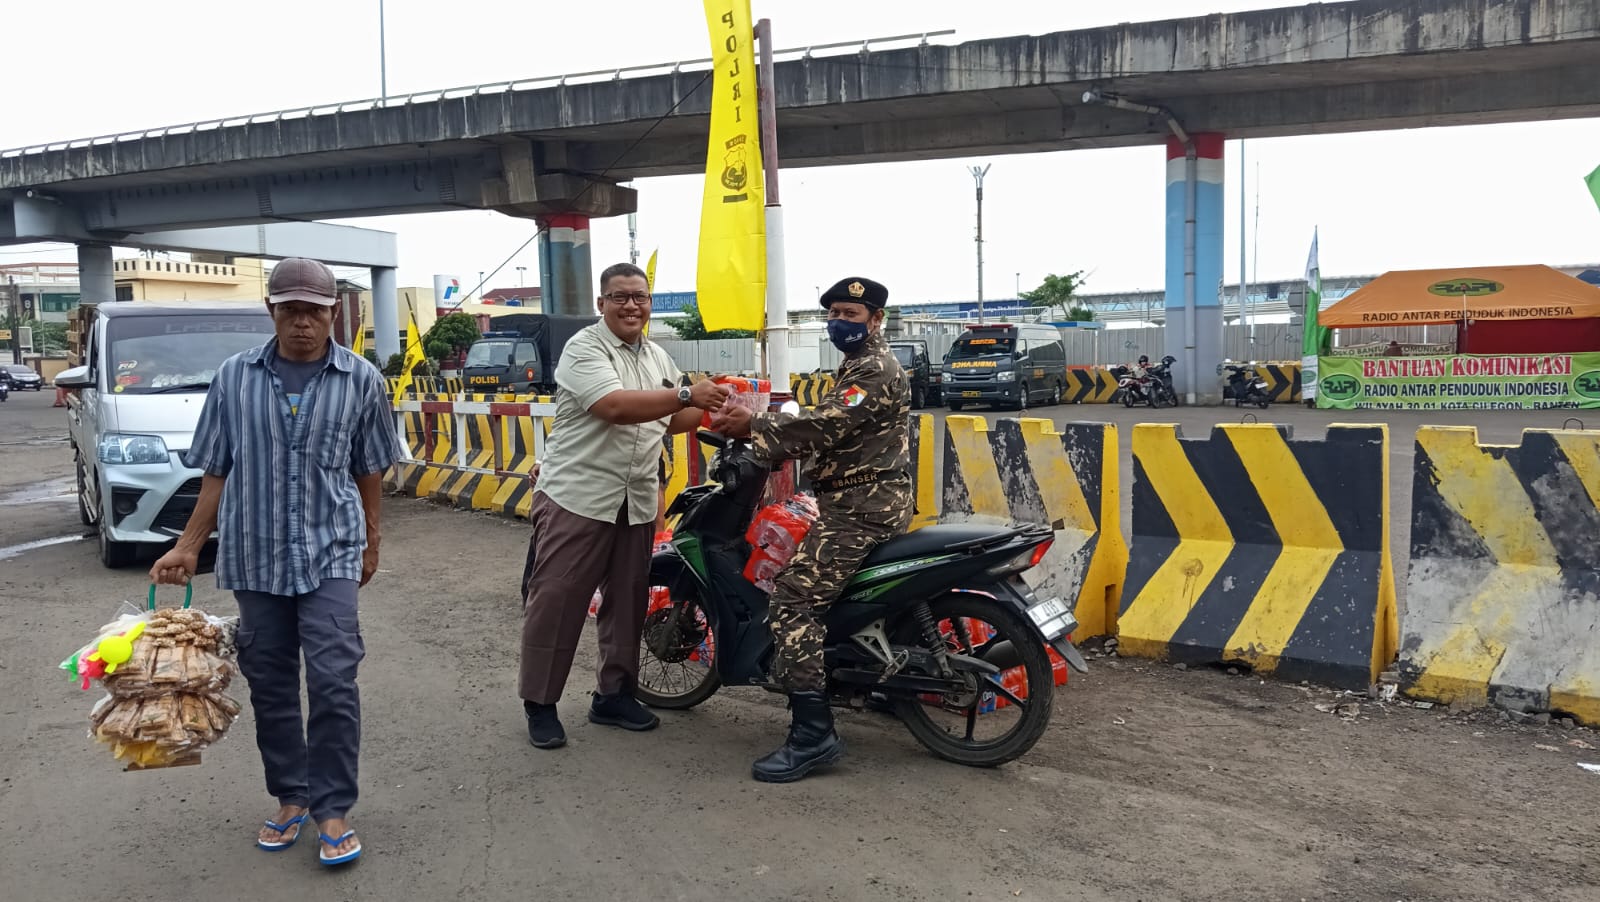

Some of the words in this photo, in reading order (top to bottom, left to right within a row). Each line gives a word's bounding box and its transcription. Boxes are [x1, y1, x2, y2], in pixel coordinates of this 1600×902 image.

[1363, 312, 1398, 322] RADIO
[1402, 311, 1440, 320] ANTAR
[1444, 309, 1504, 319] PENDUDUK
[1509, 306, 1574, 317] INDONESIA
[1358, 345, 1389, 355] BANTUA
[1363, 359, 1446, 377] BANTUAN
[1452, 356, 1572, 376] KOMUNIKASI
[470, 375, 499, 384] POLISI
[1364, 384, 1398, 397] RADIO
[1401, 383, 1437, 396] ANTAR
[1440, 382, 1502, 396] PENDUDUK
[1505, 382, 1569, 395] INDONESIA
[838, 472, 878, 487] BANSER
